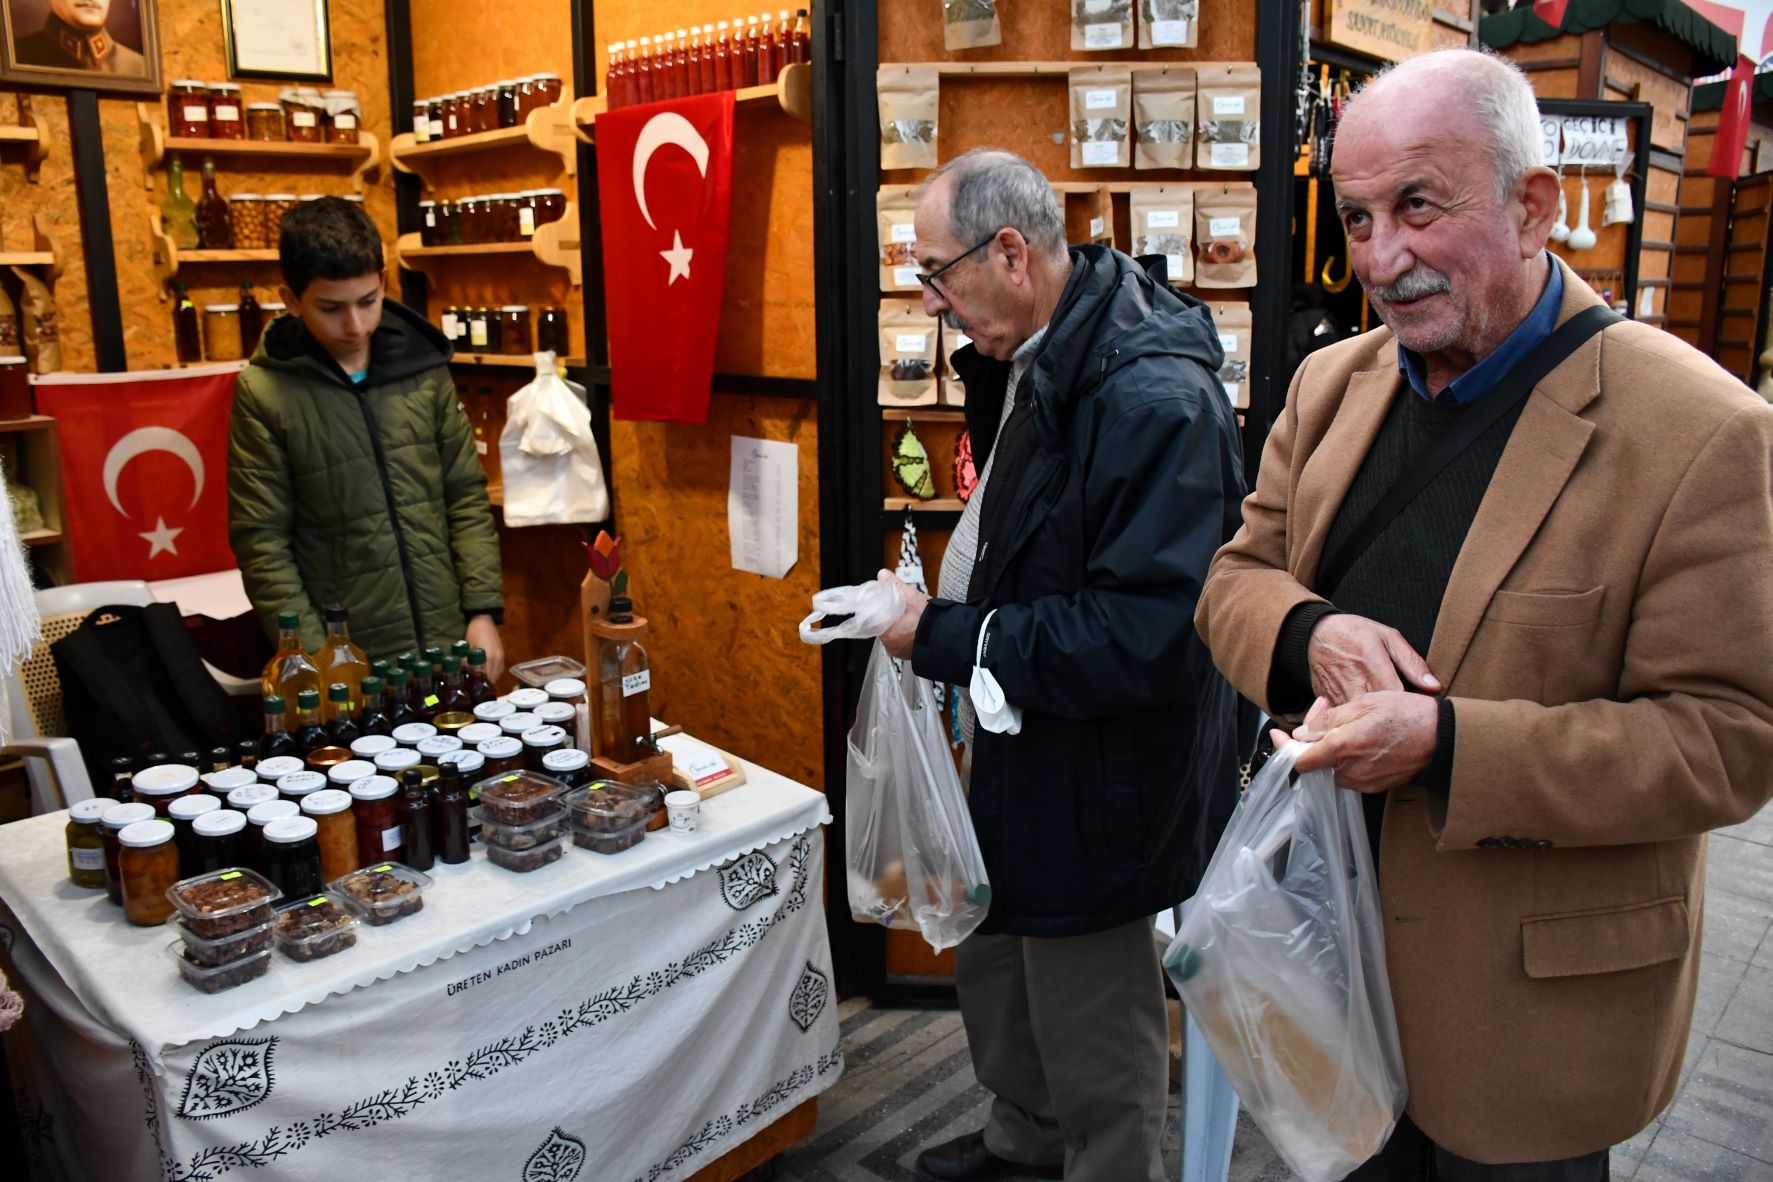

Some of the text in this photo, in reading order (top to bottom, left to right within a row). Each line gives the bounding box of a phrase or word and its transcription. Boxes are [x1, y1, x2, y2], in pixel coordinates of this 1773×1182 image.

[447, 938, 572, 997] ÜRETEN KADIN PAZARI
